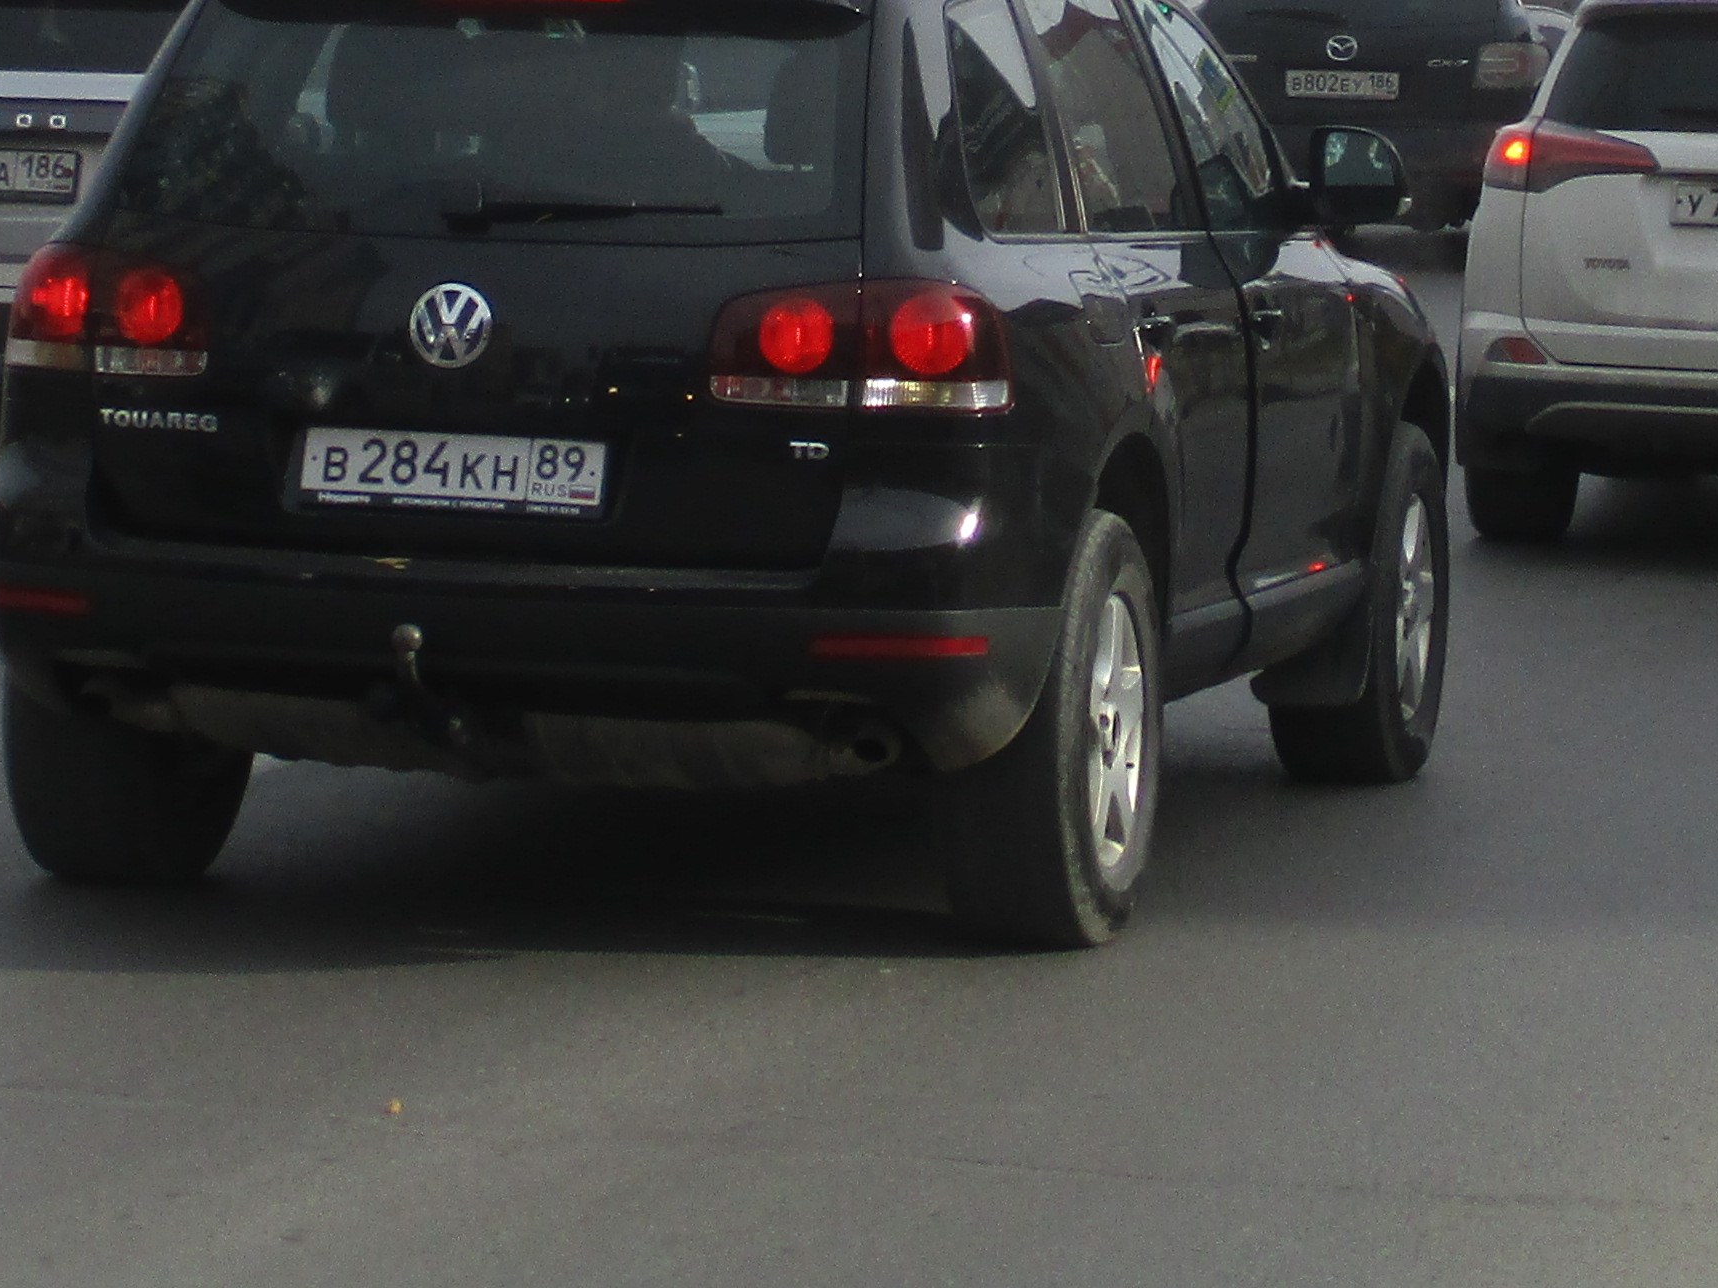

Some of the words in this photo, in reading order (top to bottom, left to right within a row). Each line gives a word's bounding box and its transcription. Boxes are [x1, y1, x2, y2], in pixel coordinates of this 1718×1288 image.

[20, 155, 66, 181] 186
[99, 408, 219, 433] TOUAREG
[535, 443, 587, 482] 89
[531, 482, 568, 498] RUS
